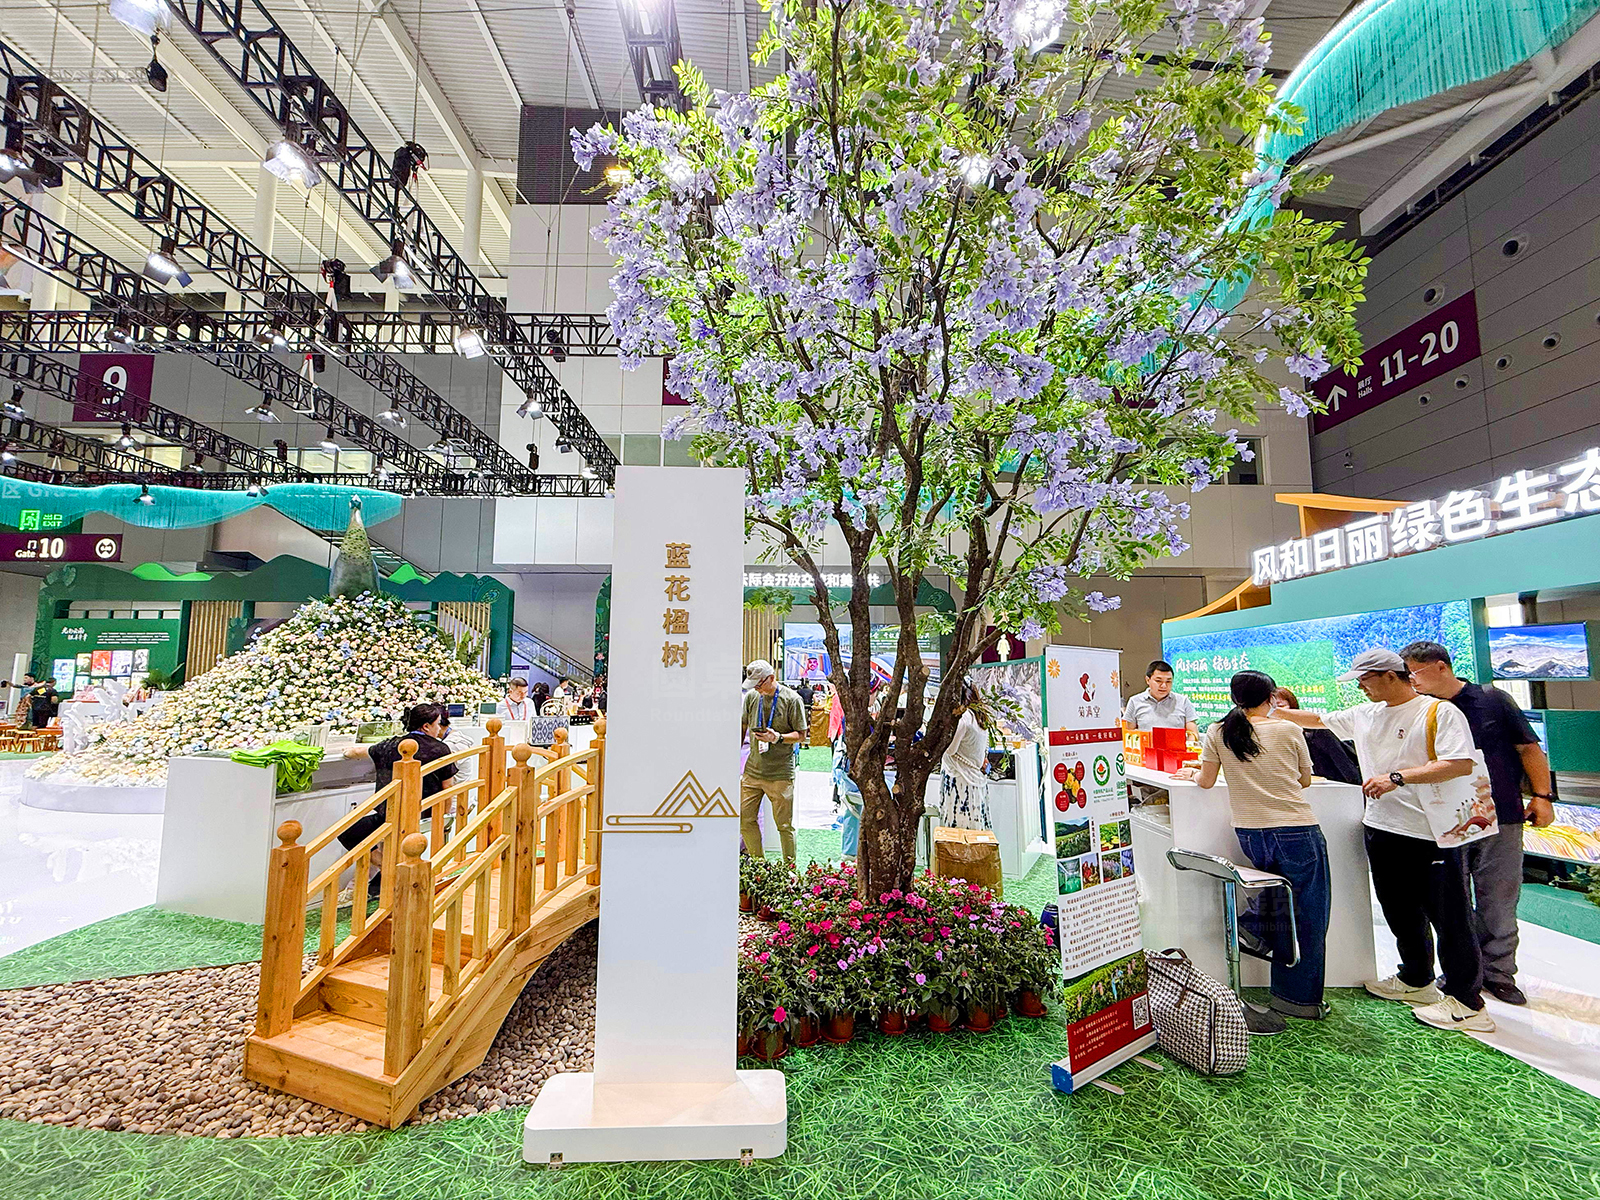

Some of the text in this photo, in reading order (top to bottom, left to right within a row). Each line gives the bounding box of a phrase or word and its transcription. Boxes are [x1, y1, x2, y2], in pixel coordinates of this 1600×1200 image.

[1379, 320, 1460, 386] 11-20
[102, 365, 128, 405] 9
[1358, 386, 1374, 399] Halls
[42, 513, 63, 521] 出口
[15, 537, 64, 559] Gate 10
[661, 542, 692, 669] 蓝花楹树
